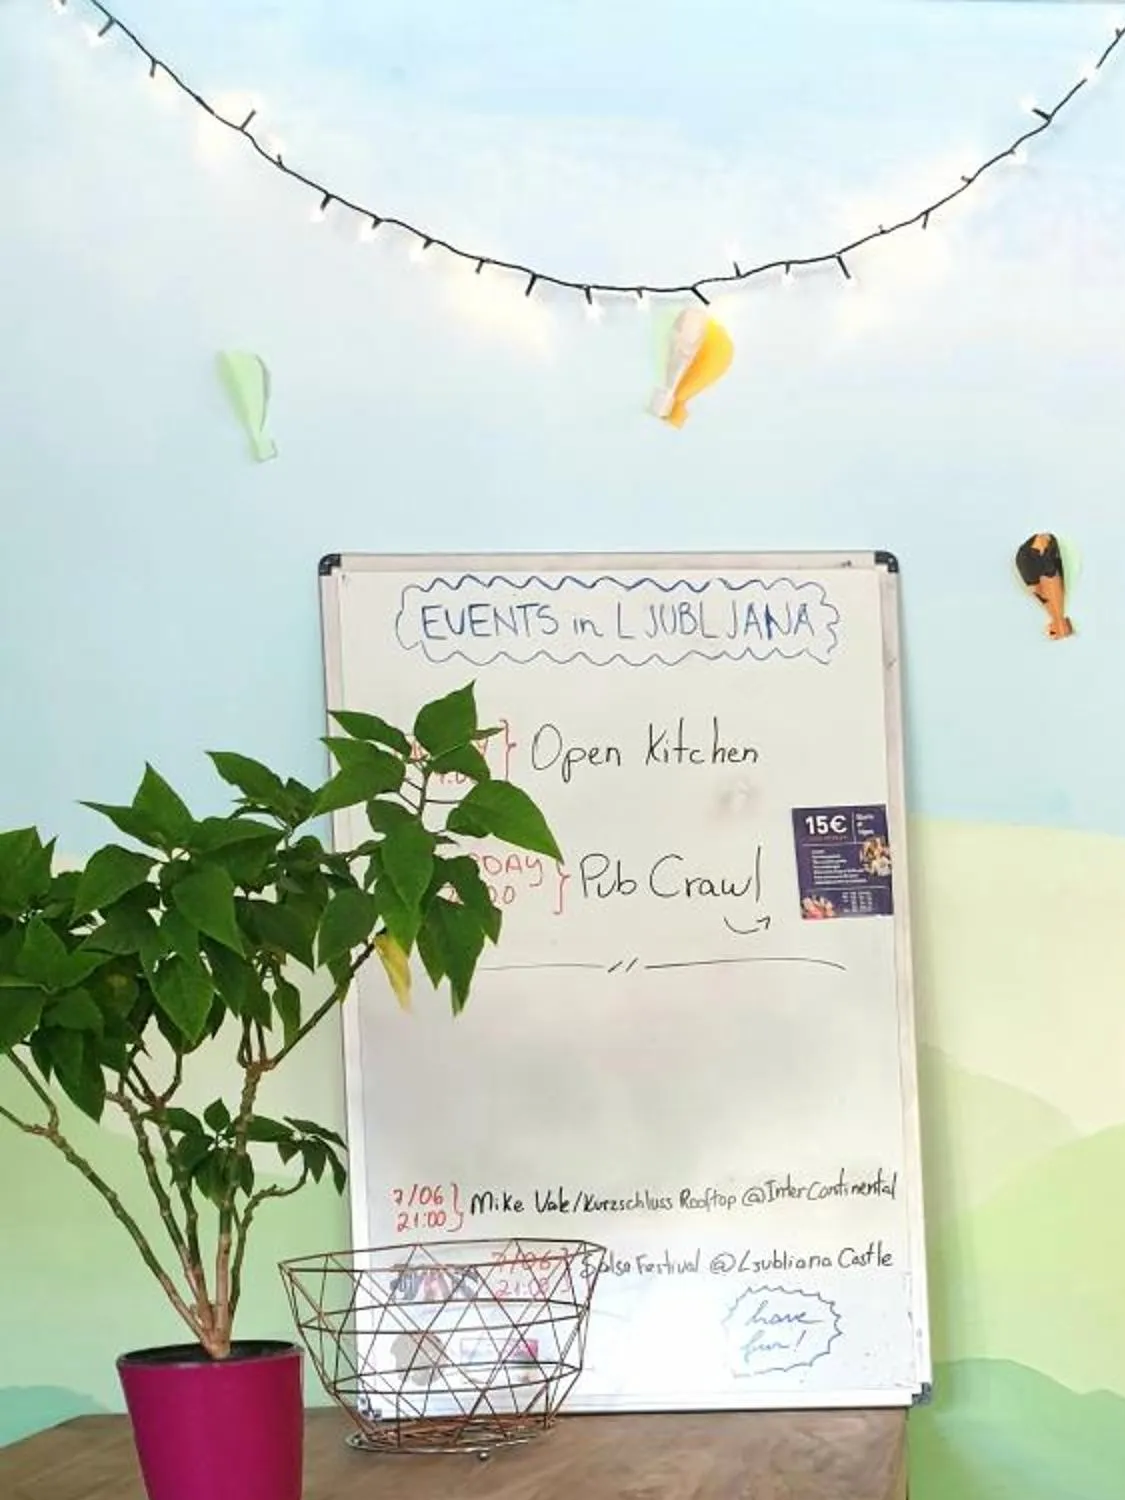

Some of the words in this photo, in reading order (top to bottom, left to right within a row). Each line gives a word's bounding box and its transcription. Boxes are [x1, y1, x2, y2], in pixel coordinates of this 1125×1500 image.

[420, 603, 560, 640] EVENTS
[572, 615, 604, 638] in
[617, 600, 815, 641] LJUBLJANA
[531, 723, 622, 784] Open
[645, 715, 759, 767] Kitchen
[804, 814, 848, 836] 15€
[579, 853, 638, 899] Pub
[650, 845, 762, 903] Crawl
[470, 1189, 525, 1216] Mike
[679, 1187, 737, 1212] Rooftop
[397, 1210, 447, 1233] 21:00
[635, 1247, 701, 1275] Festival
[837, 1240, 894, 1270] Castle
